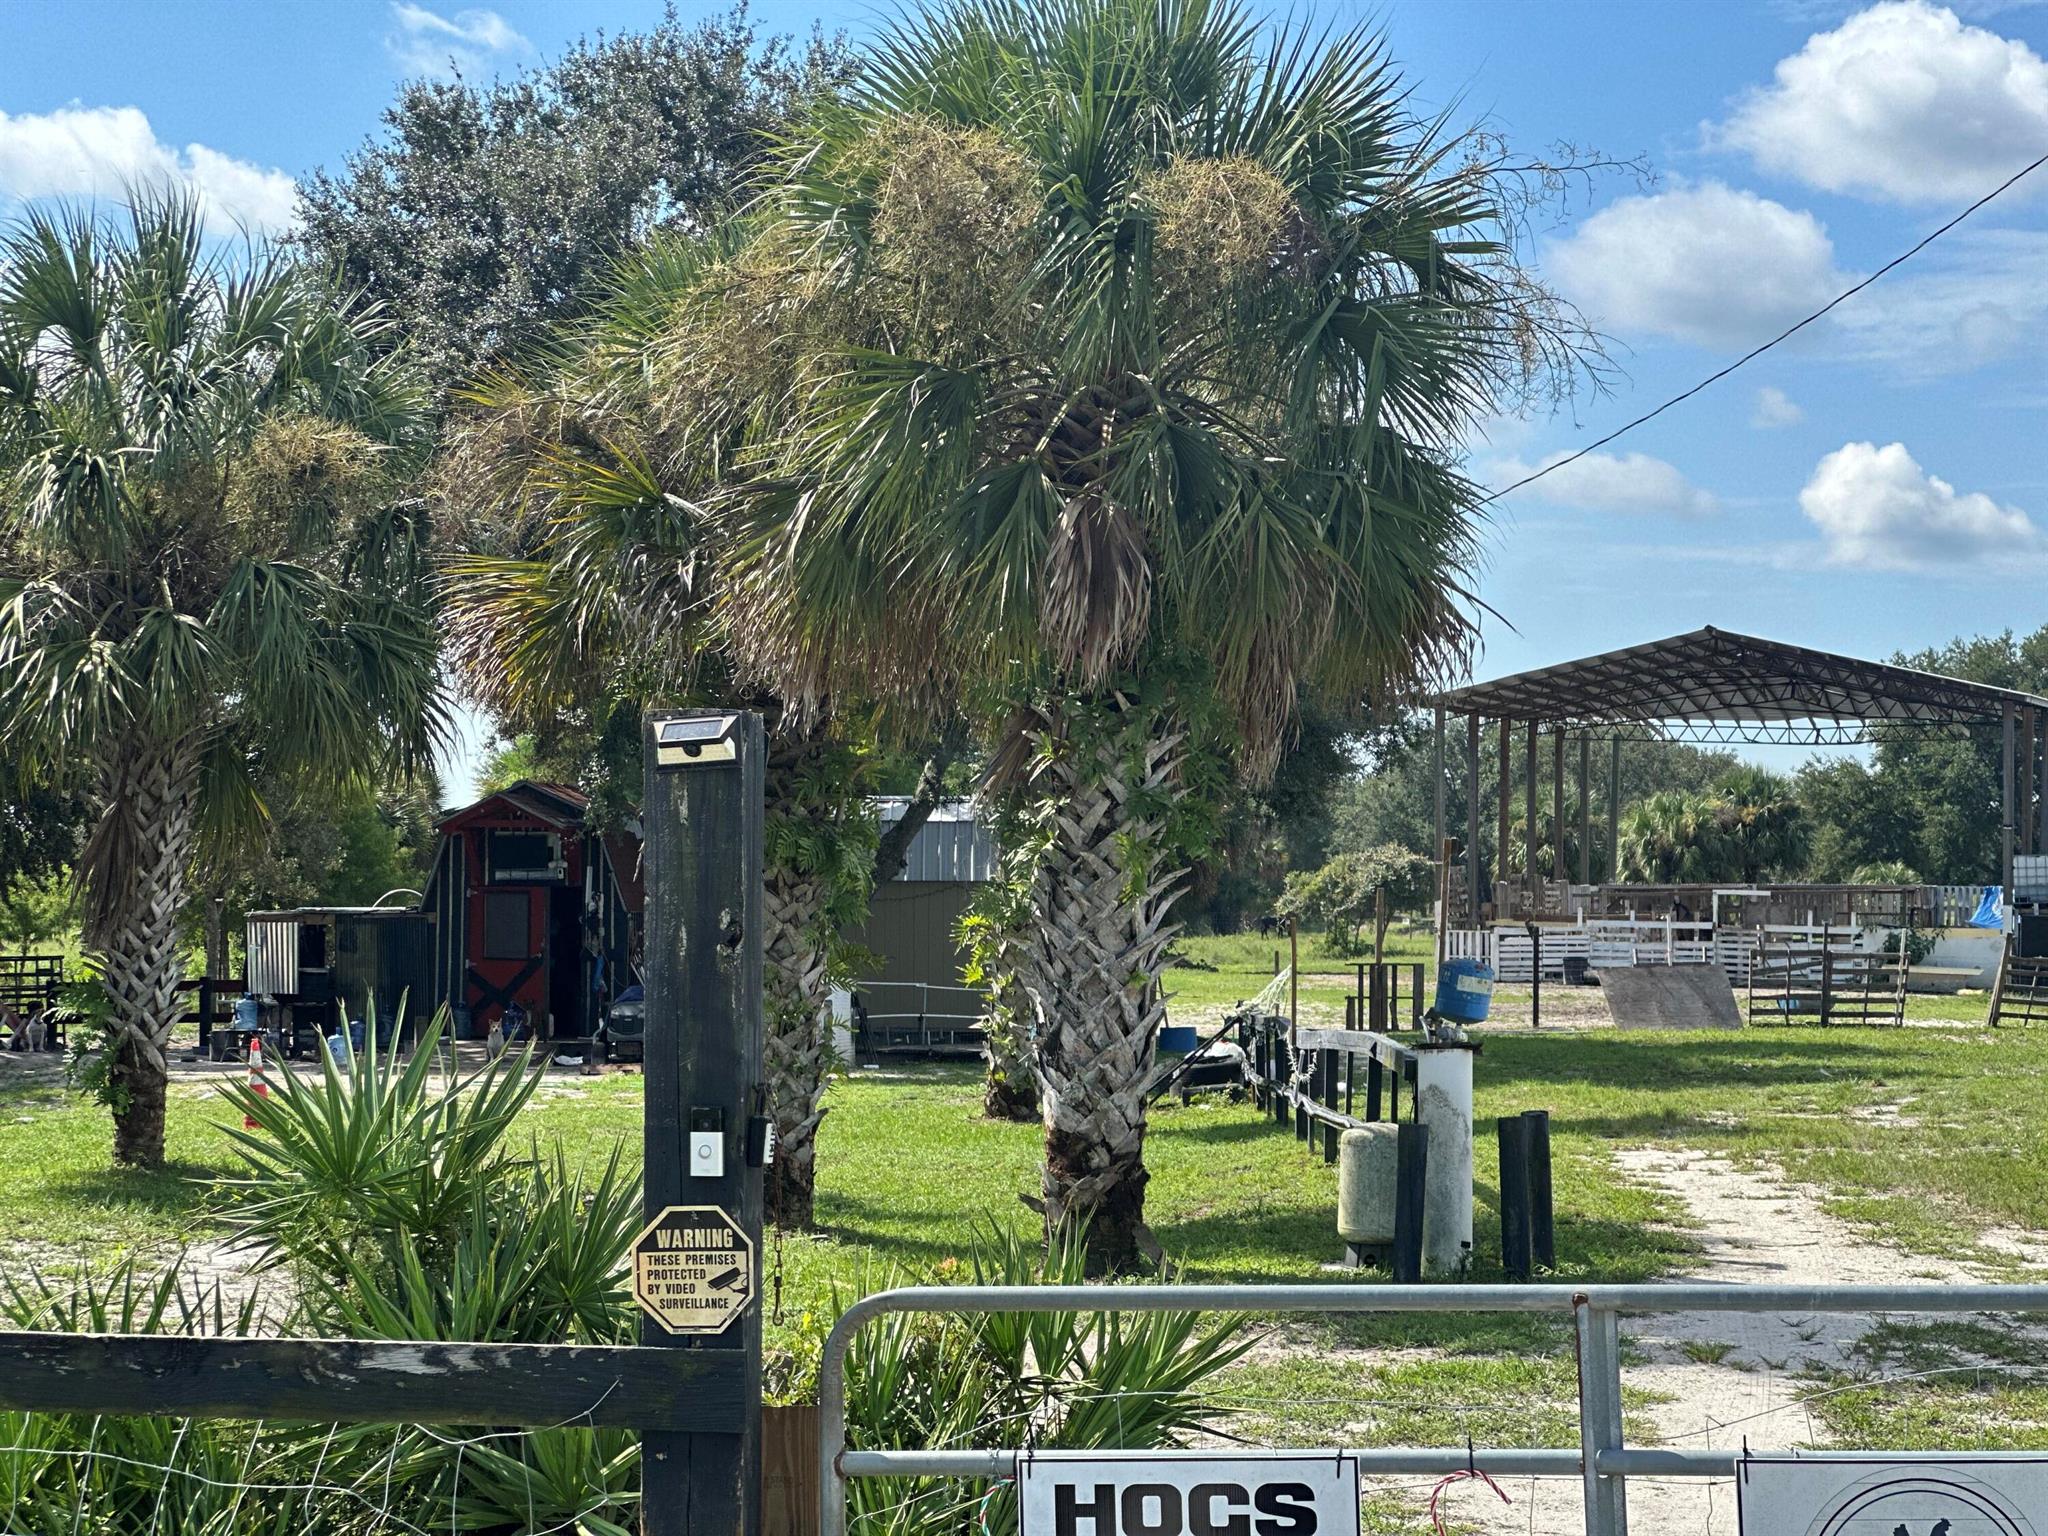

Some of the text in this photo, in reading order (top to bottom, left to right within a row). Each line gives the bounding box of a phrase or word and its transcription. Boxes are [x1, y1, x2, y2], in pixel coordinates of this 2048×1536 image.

[656, 1228, 733, 1248] WARNING
[647, 1254, 737, 1266] THESE PREMISES
[647, 1269, 706, 1280] PROTECTED
[647, 1283, 696, 1295] BY VIDEO
[659, 1298, 729, 1309] SURVEILLANCE
